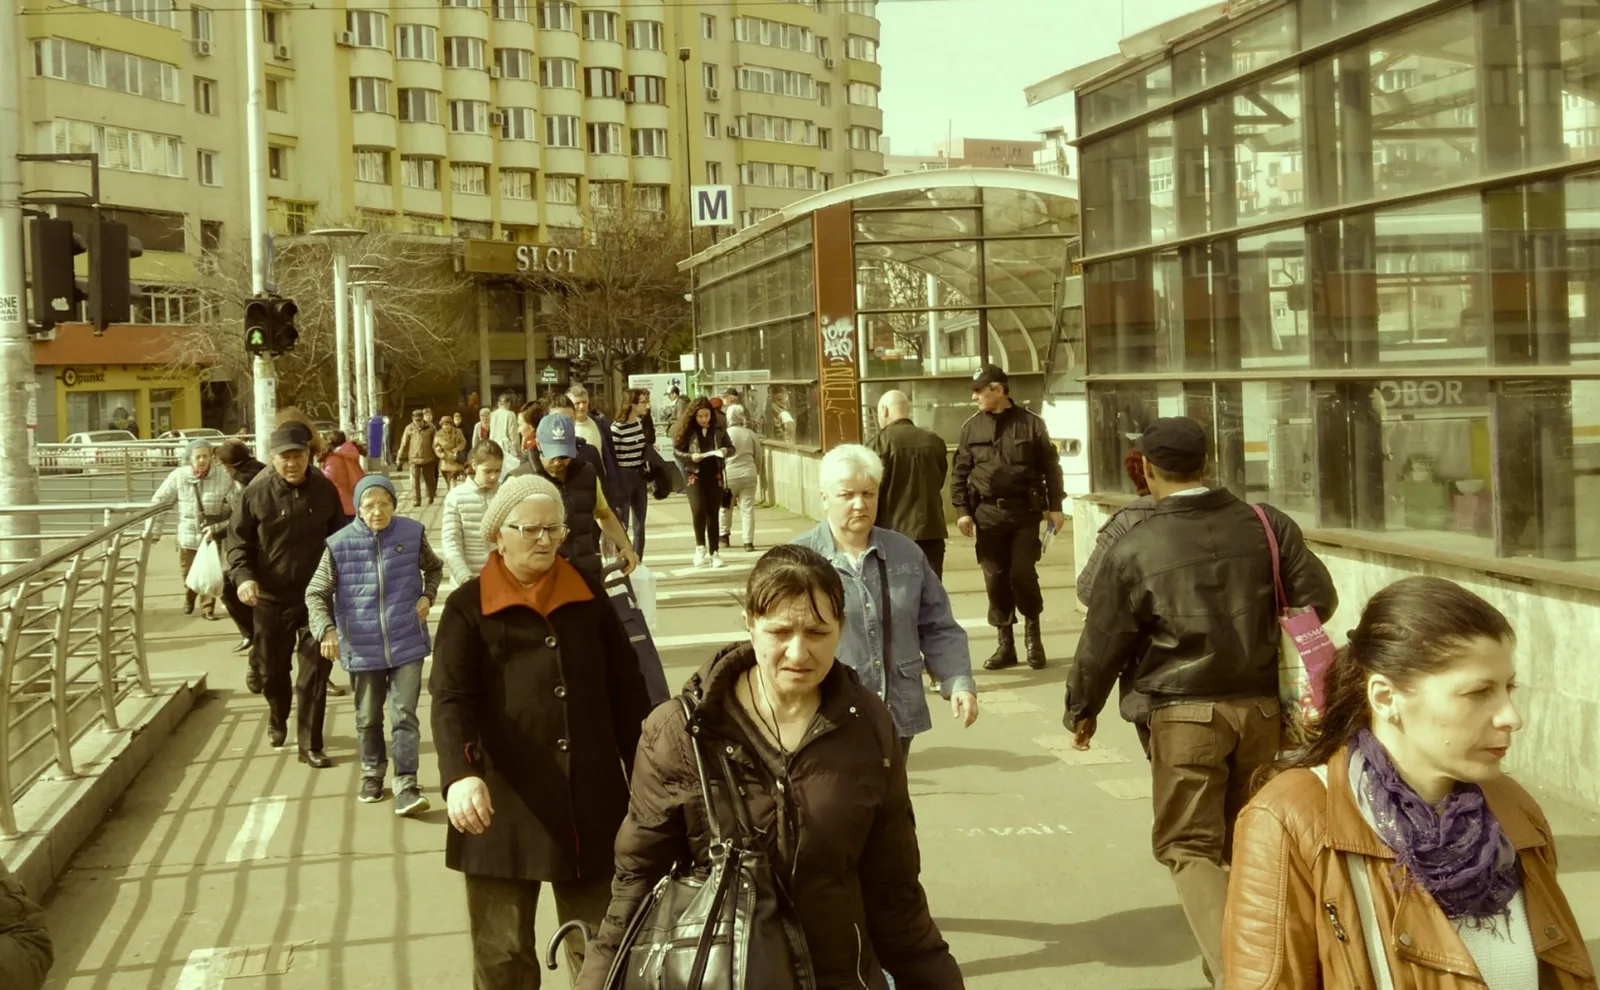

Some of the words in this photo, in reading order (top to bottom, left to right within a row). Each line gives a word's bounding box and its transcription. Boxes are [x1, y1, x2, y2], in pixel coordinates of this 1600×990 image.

[698, 190, 727, 220] M
[516, 246, 577, 273] SLOT
[1380, 380, 1463, 408] OBOR
